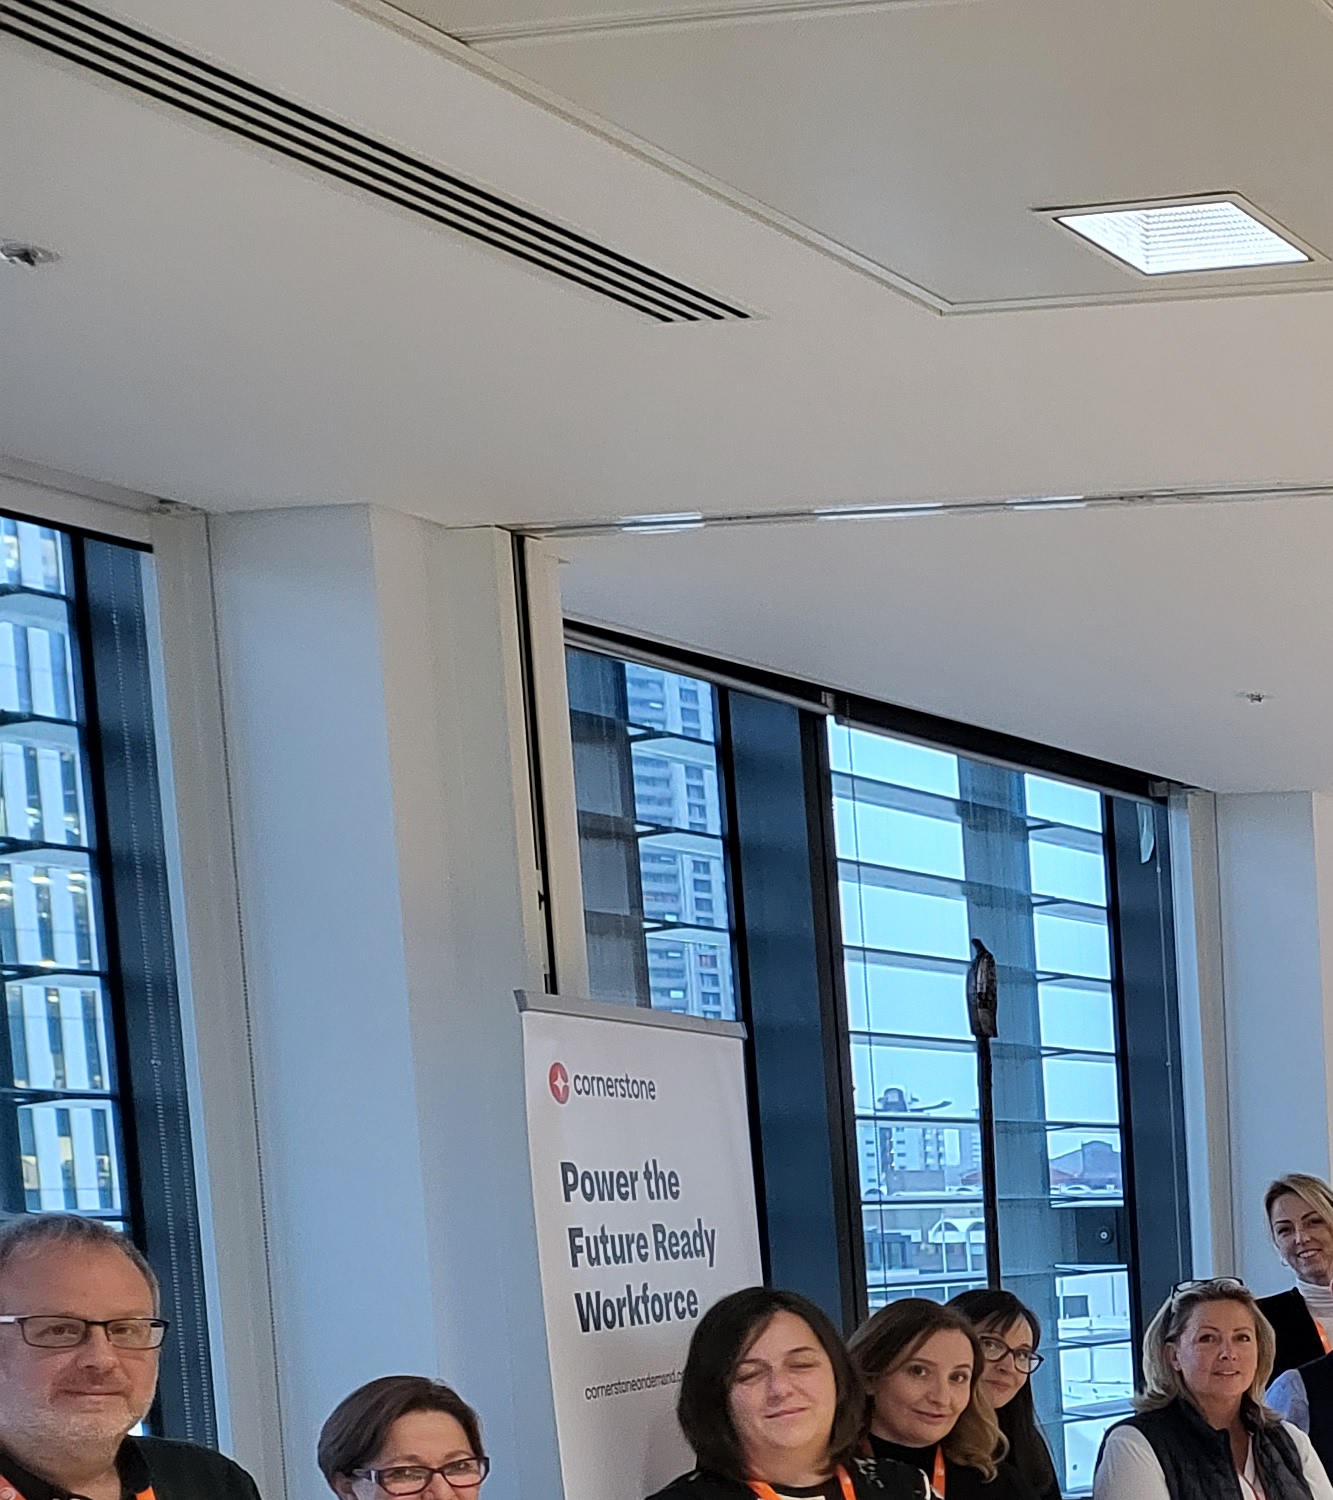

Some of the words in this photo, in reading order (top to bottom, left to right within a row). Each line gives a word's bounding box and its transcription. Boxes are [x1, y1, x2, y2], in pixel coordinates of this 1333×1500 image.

[573, 1072, 656, 1101] cornerstone
[560, 1161, 639, 1203] Power
[643, 1159, 681, 1201] the
[569, 1224, 650, 1269] Future
[653, 1218, 716, 1269] Ready
[574, 1283, 699, 1333] Workforce
